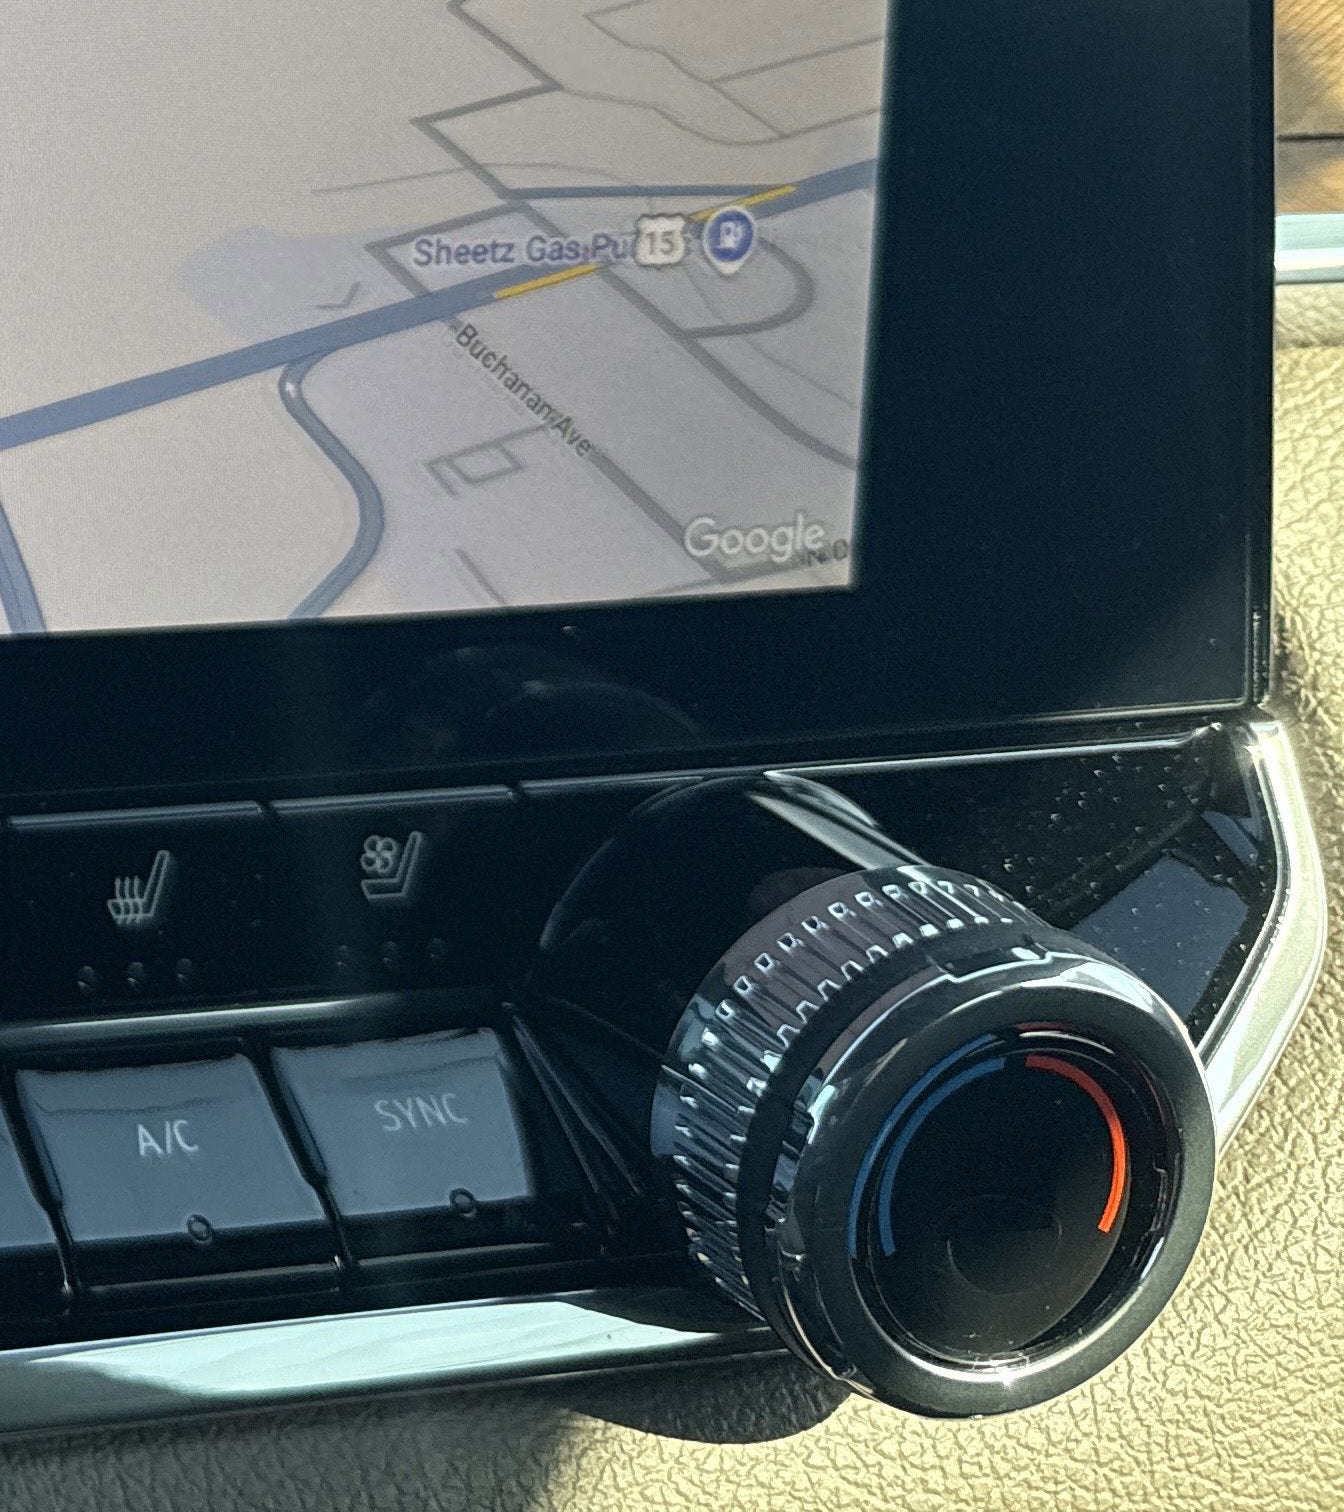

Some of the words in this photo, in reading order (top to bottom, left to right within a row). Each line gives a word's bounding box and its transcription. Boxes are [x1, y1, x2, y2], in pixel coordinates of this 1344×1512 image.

[413, 237, 515, 266] Sheetz
[526, 234, 583, 262] Gas
[590, 233, 635, 259] Pu
[645, 234, 674, 255] 15
[455, 322, 554, 422] Buchanan
[552, 415, 593, 458] Ave
[683, 511, 826, 564] Google
[374, 1093, 469, 1132] SYNC
[136, 1119, 199, 1157] A/C
